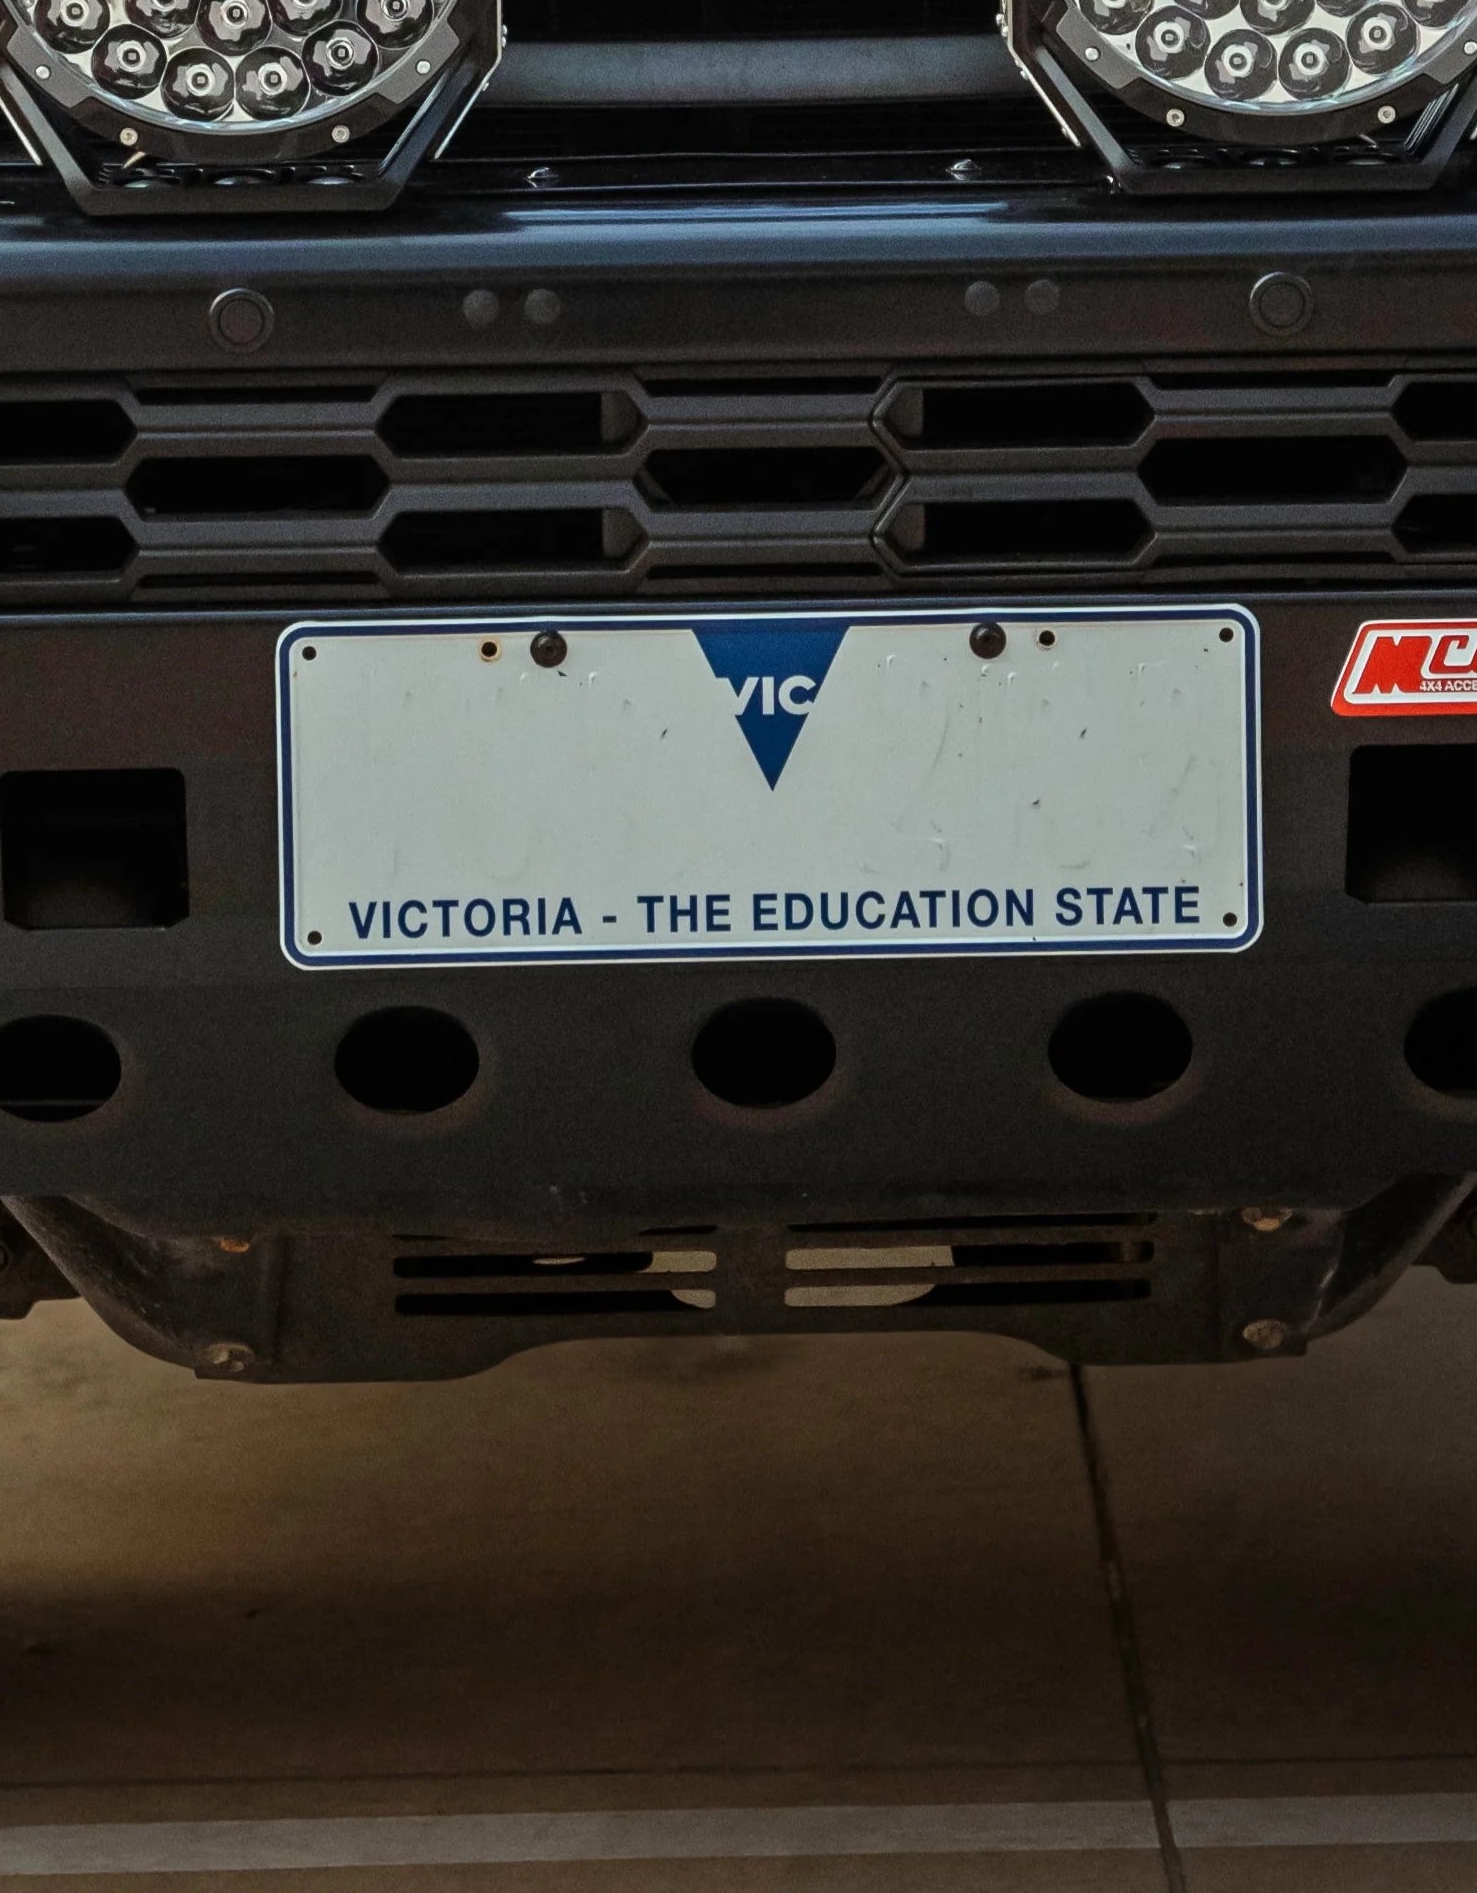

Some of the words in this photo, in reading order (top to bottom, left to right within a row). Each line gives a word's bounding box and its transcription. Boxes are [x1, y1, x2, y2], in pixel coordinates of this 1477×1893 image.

[716, 675, 816, 715] VIC
[1419, 680, 1442, 692] 4X4
[348, 896, 583, 939] VICTORIA
[637, 894, 732, 933] THE
[752, 888, 1035, 931] EDUCATION
[1055, 885, 1200, 926] STATE
